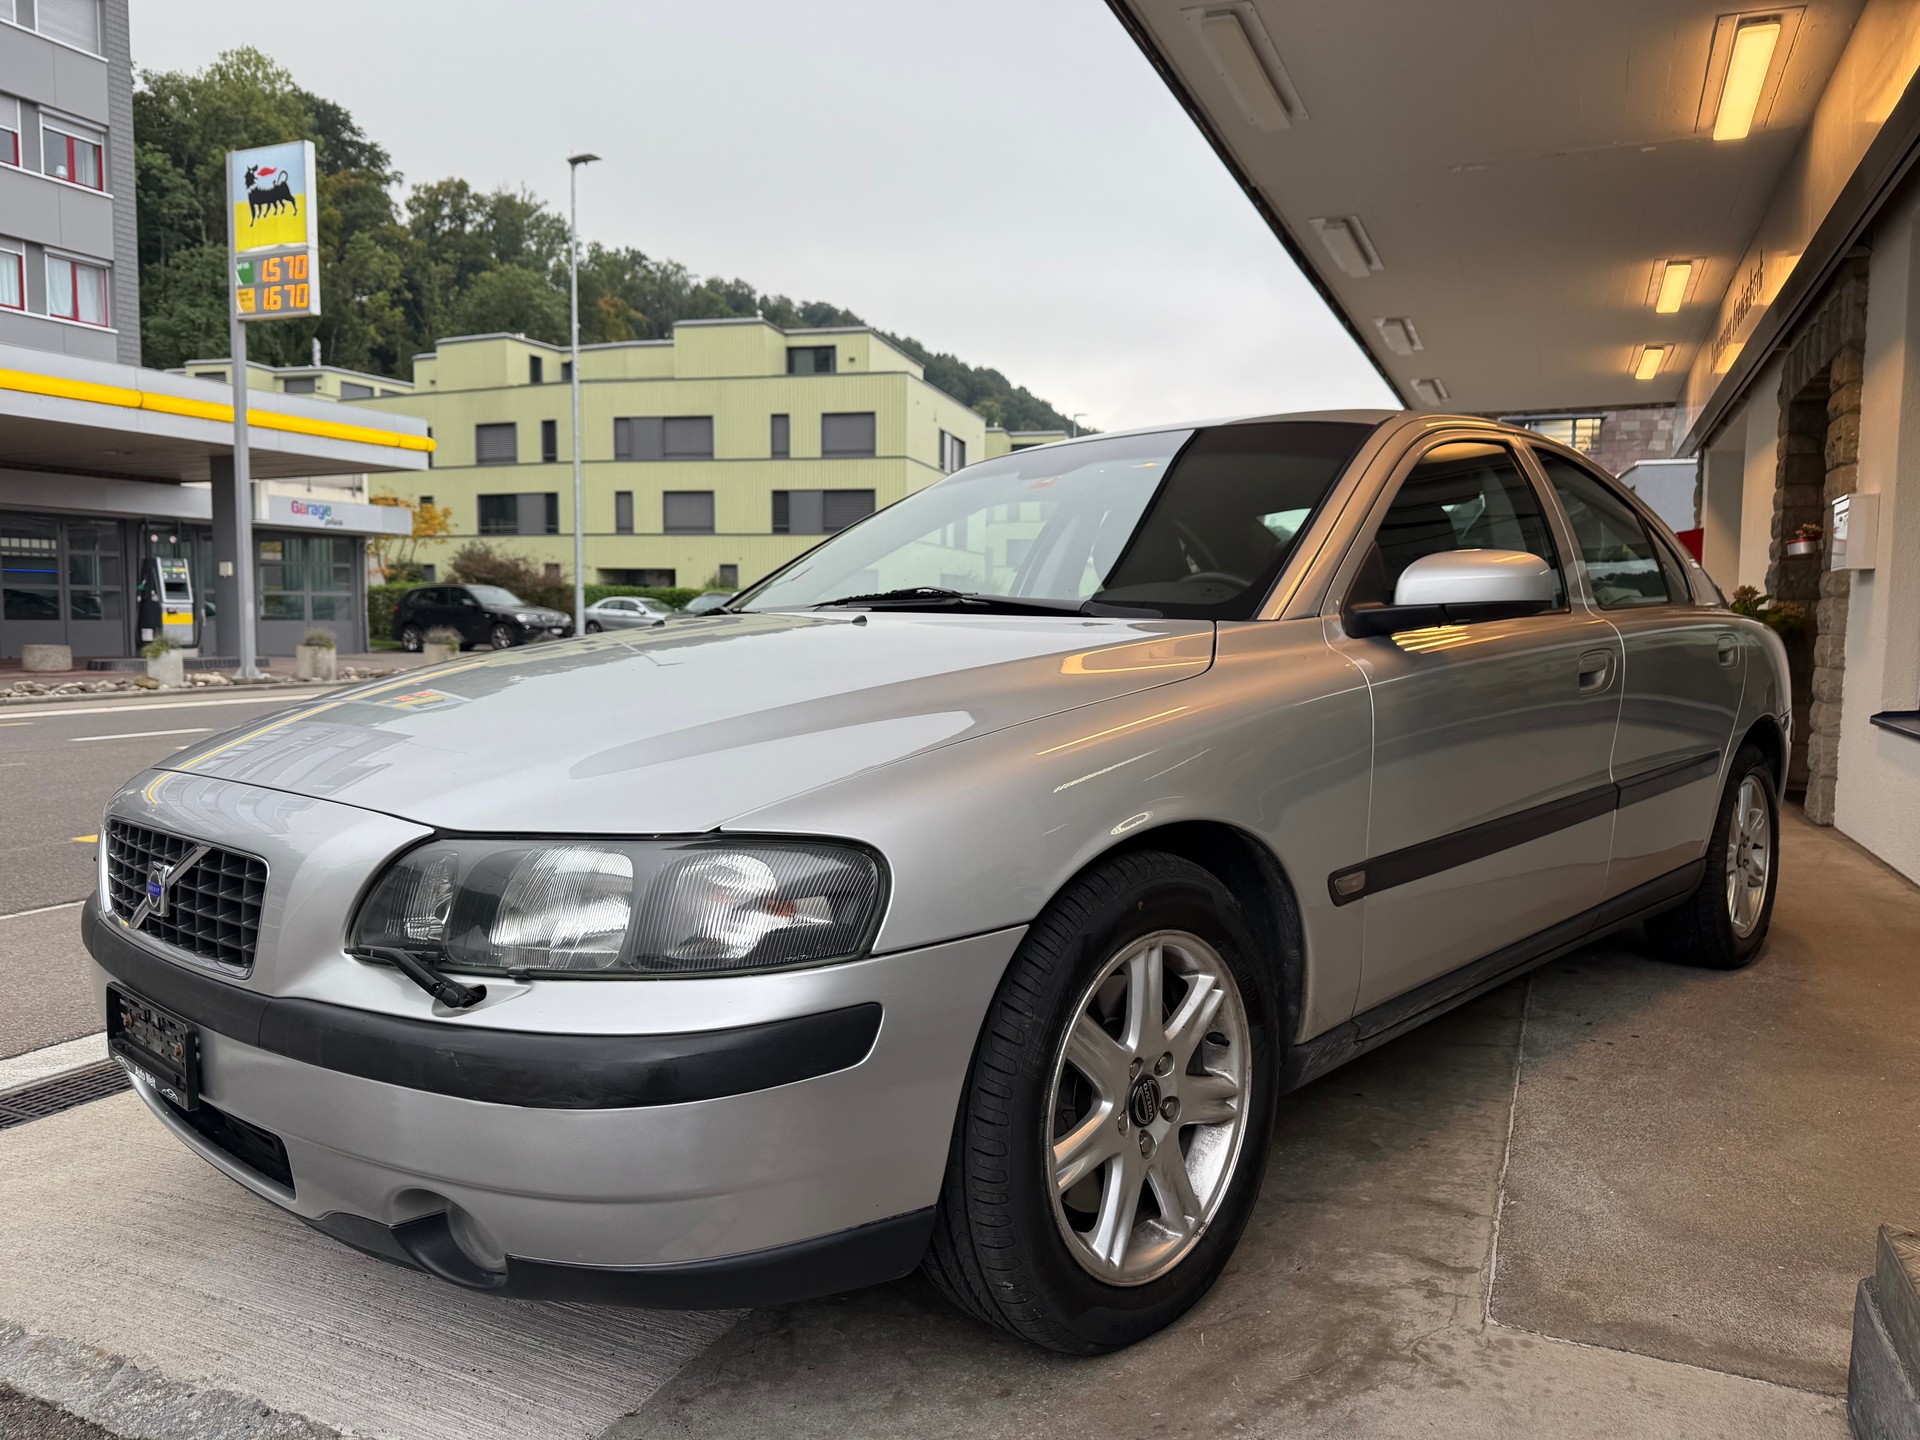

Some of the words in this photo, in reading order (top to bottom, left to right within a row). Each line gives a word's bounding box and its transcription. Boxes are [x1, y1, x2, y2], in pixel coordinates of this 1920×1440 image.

[291, 500, 332, 520] Garage
[134, 1066, 145, 1081] Auto
[1142, 1082, 1154, 1122] VOLVO
